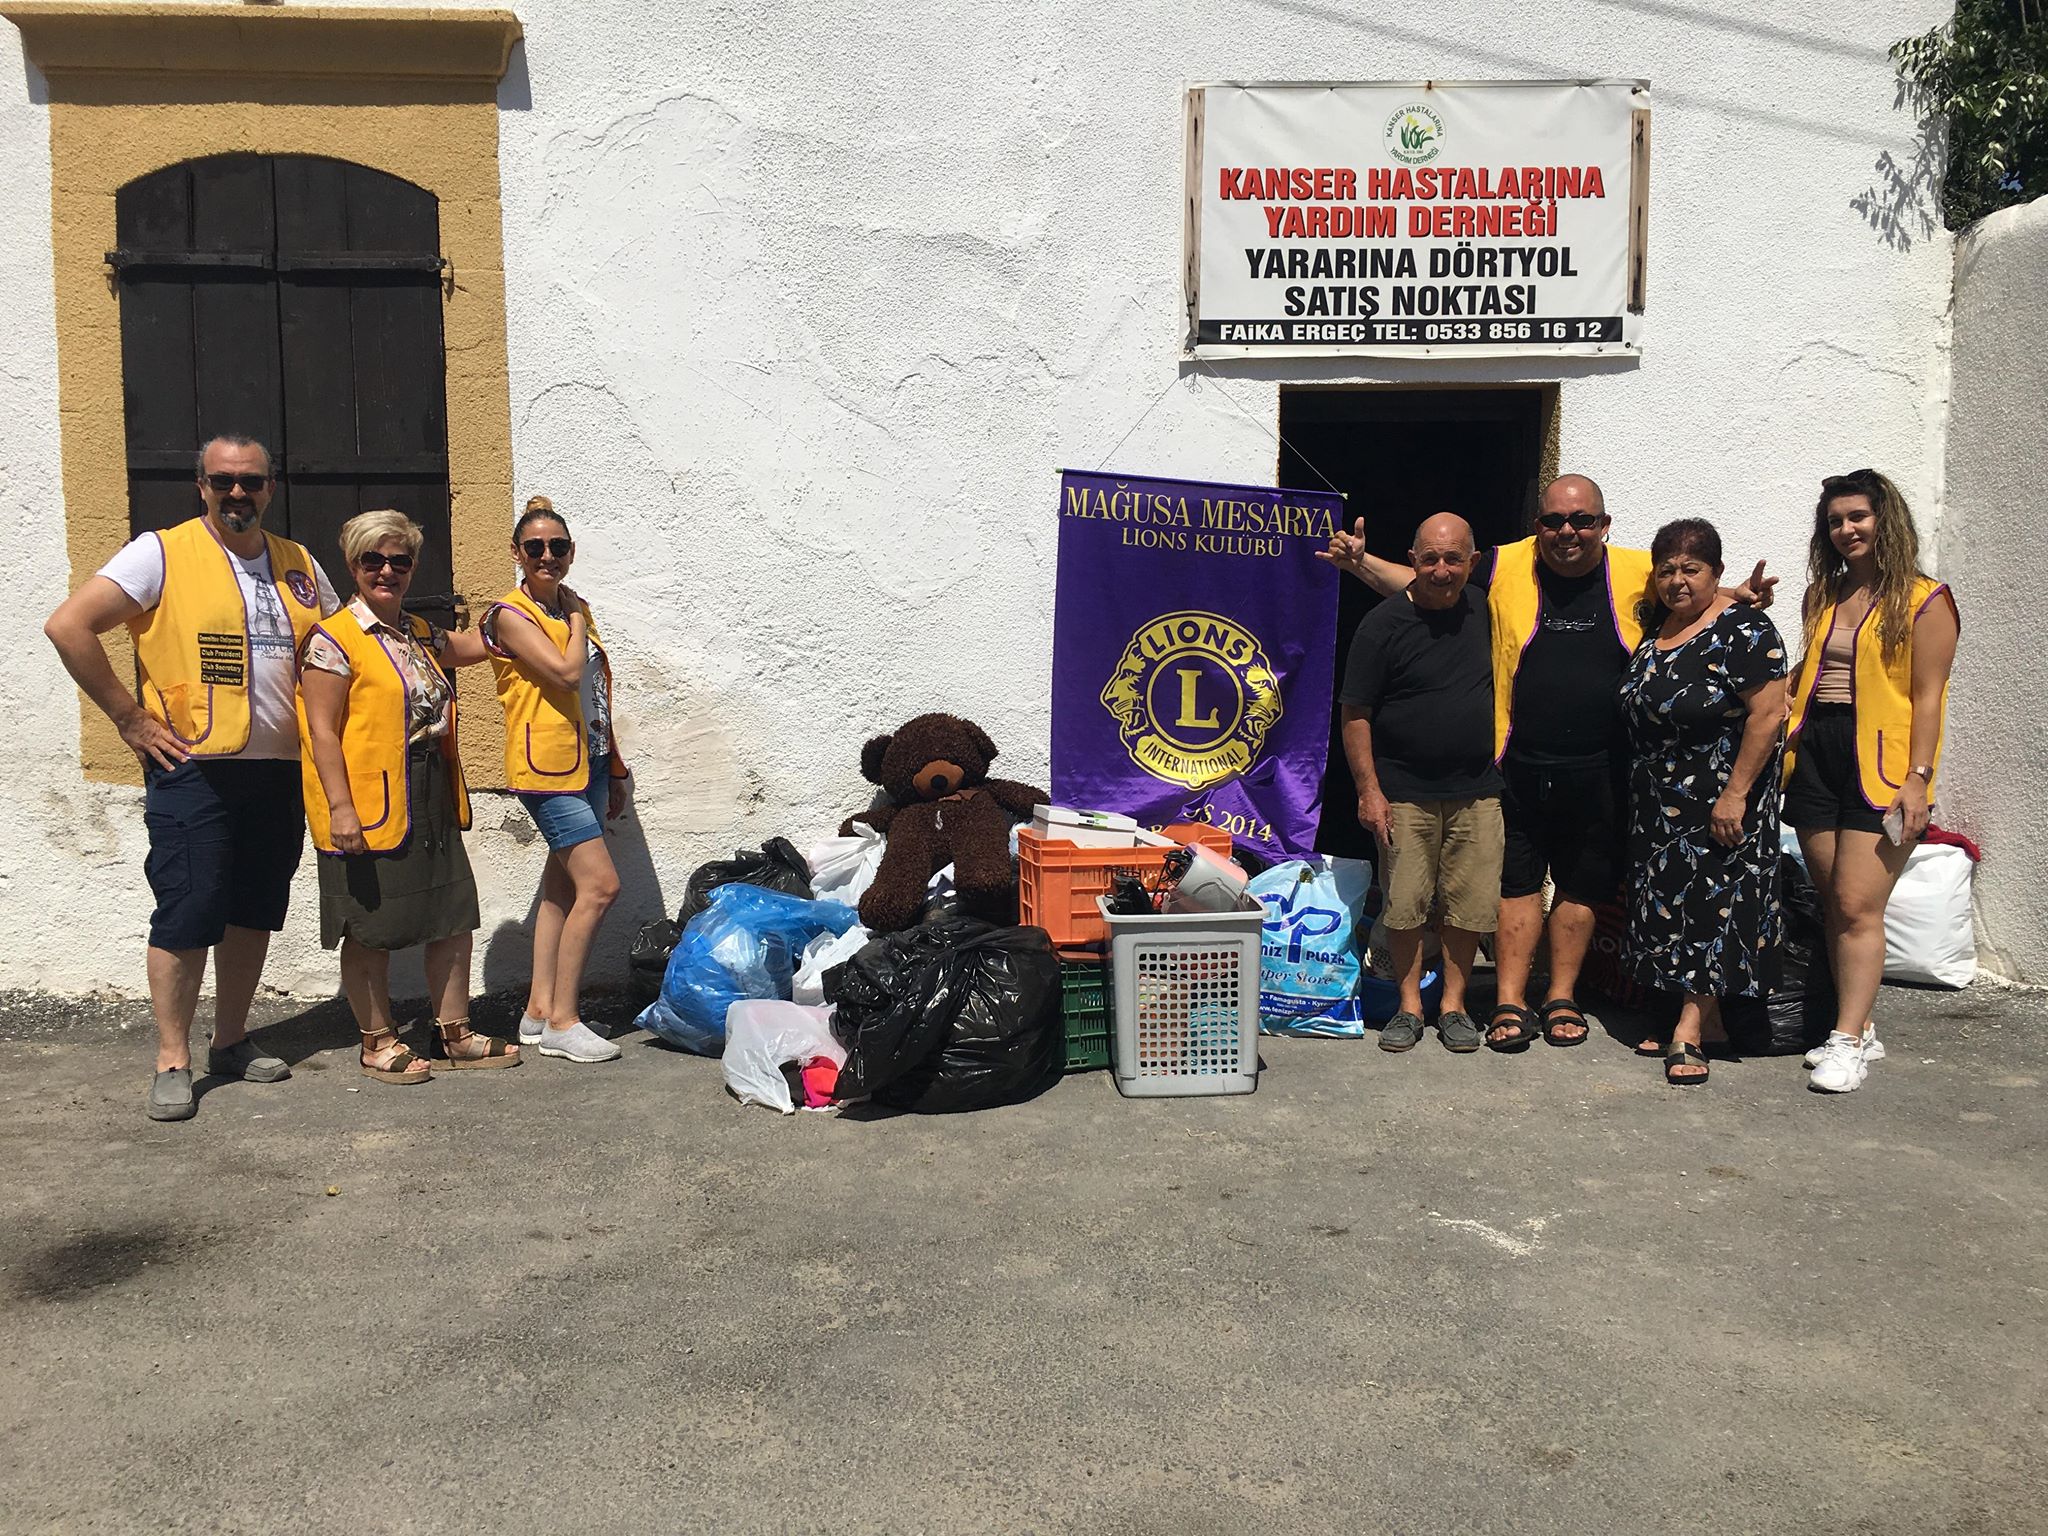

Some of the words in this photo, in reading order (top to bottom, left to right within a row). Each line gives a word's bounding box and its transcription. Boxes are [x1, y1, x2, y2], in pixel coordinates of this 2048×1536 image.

[1386, 110, 1405, 138] KANSER
[1405, 105, 1444, 138] HASTALARINA
[1390, 146, 1412, 164] YARDIM
[1219, 167, 1357, 200] KANSER
[1367, 166, 1605, 200] HASTALARINA
[1263, 206, 1397, 239] YARDIM
[1408, 198, 1558, 238] DERNEĞİ
[1244, 247, 1418, 279] YARARINA
[1429, 241, 1578, 278] DÖRTYOL
[1284, 285, 1381, 321] SATIŞ
[1391, 284, 1536, 316] NOKTASI
[1292, 324, 1366, 342] ERGEÇ
[1373, 324, 1418, 340] TEL:
[1424, 324, 1481, 341] 0533
[1489, 323, 1531, 340] 856
[1540, 323, 1566, 339] 16
[1577, 322, 1602, 339] 12
[1064, 482, 1192, 528] MAĞUSA
[1200, 498, 1335, 539] MESARYA
[1121, 527, 1187, 551] LIONS
[1194, 534, 1283, 557] KULÜBÜ
[201, 648, 214, 657] Club
[214, 649, 241, 658] President
[1146, 620, 1248, 661] LIONS
[202, 662, 215, 670] Club
[214, 663, 241, 673] Secretary
[202, 674, 215, 682] Club
[1175, 669, 1220, 728] L
[1143, 741, 1244, 776] INTERNATIONAL
[1217, 811, 1272, 842] 2014
[1295, 971, 1332, 985] Store
